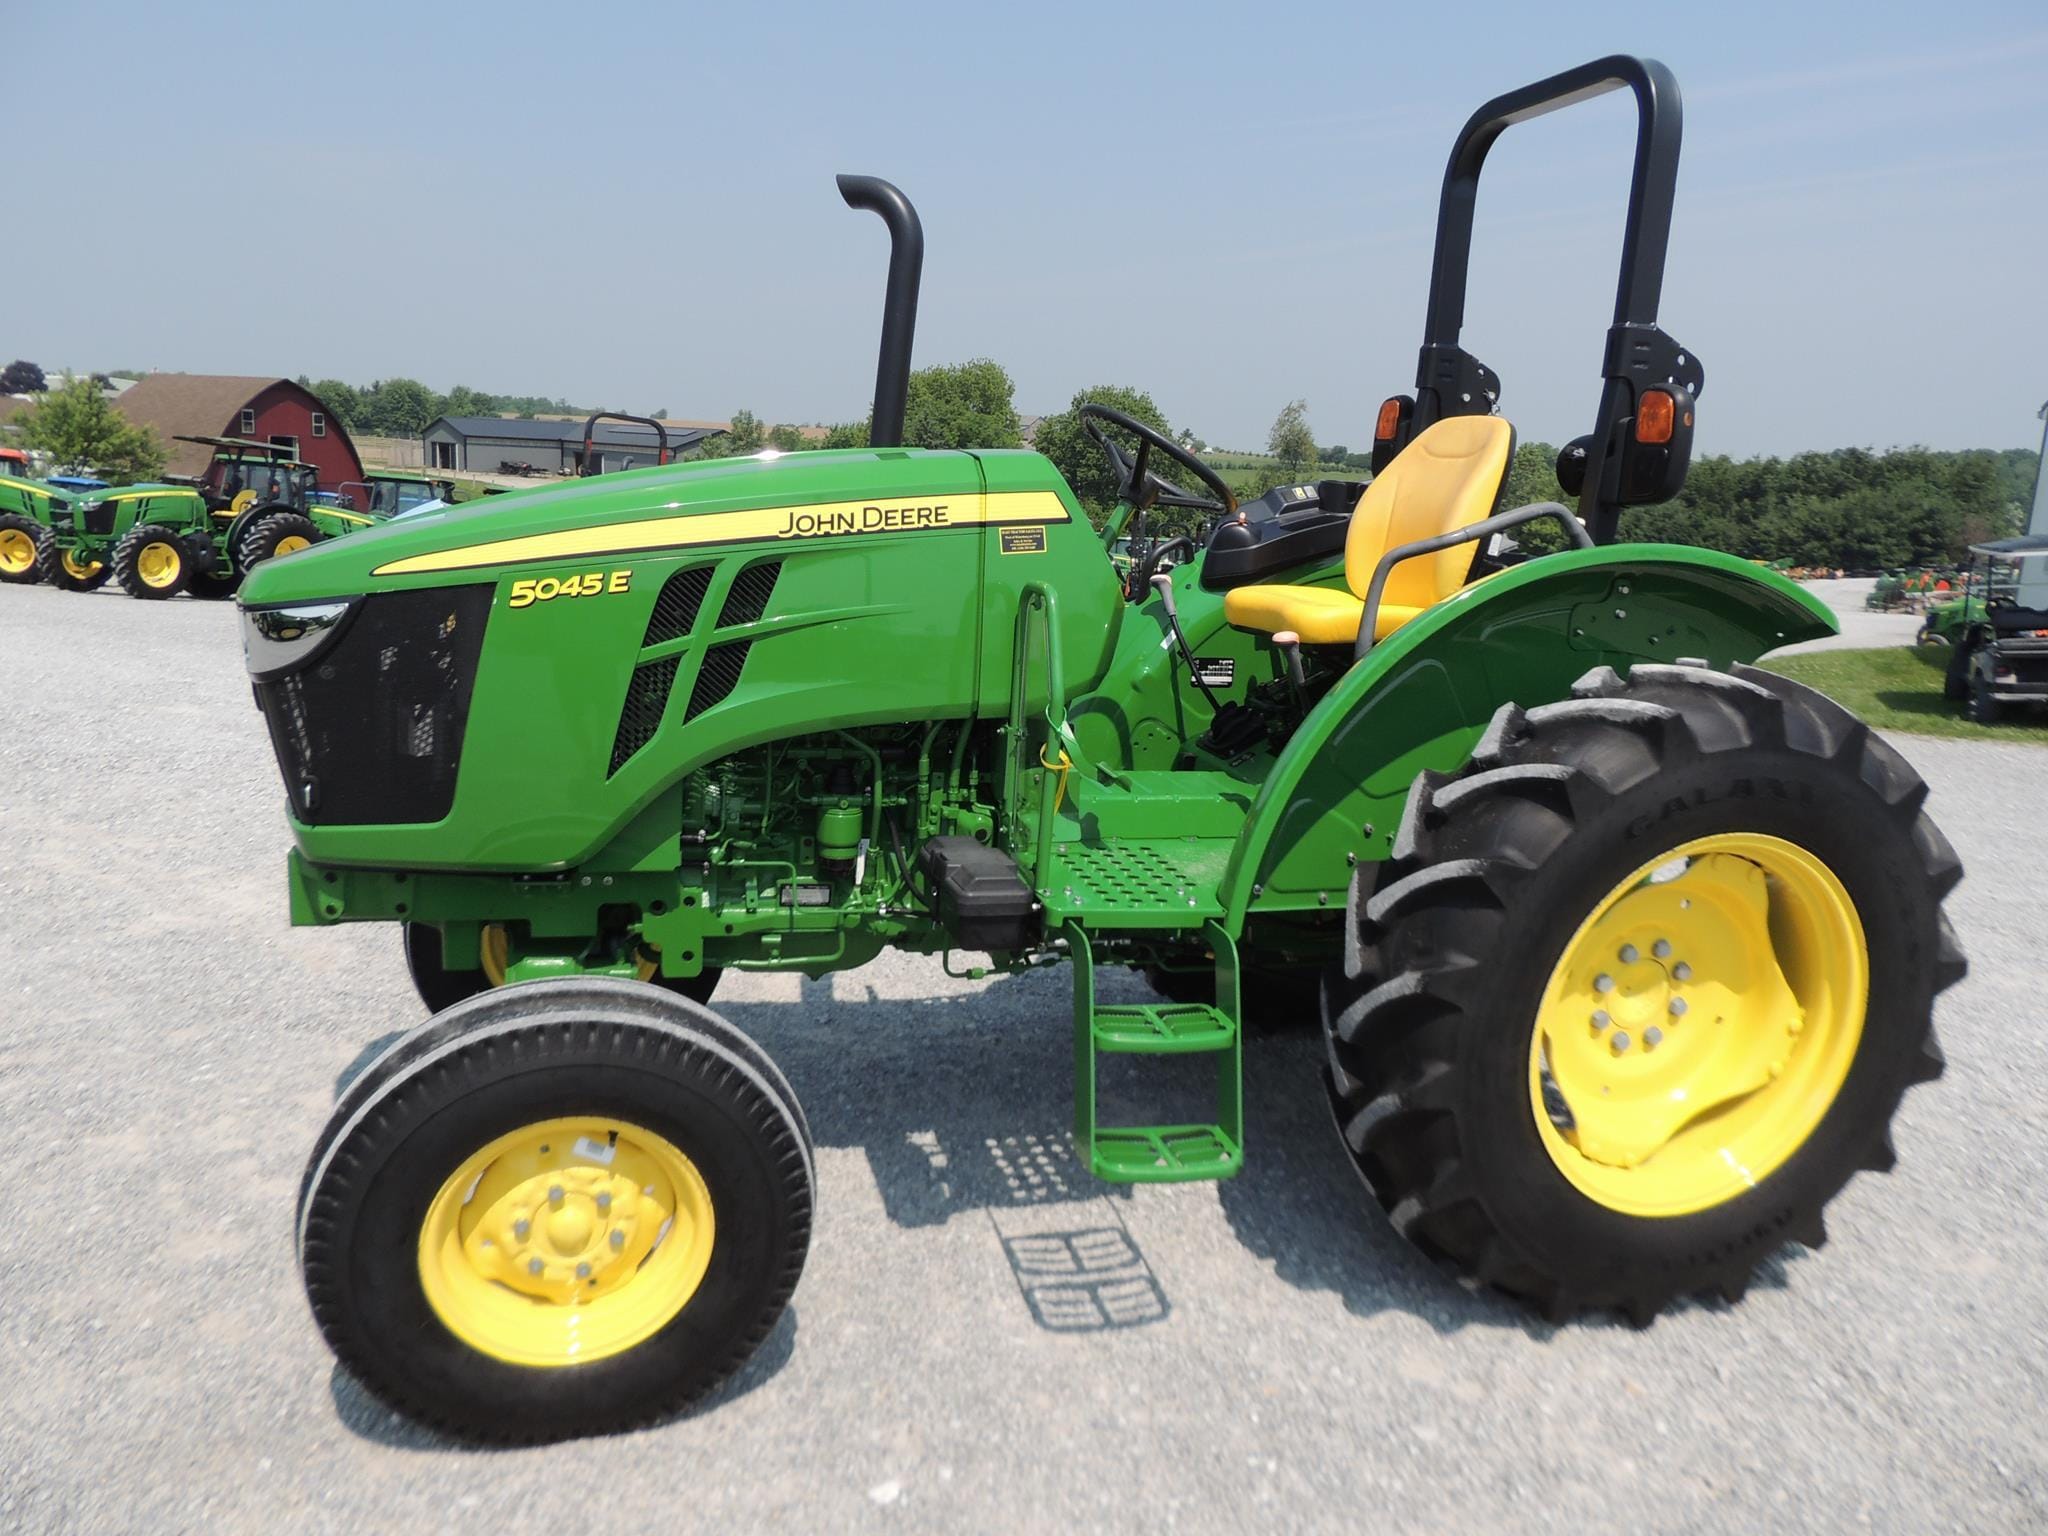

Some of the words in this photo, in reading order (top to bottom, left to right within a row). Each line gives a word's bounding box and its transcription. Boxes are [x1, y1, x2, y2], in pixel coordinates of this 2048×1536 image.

[778, 511, 855, 535] JOHN
[863, 506, 949, 529] DEERE
[509, 573, 604, 608] 5045
[607, 570, 633, 594] E
